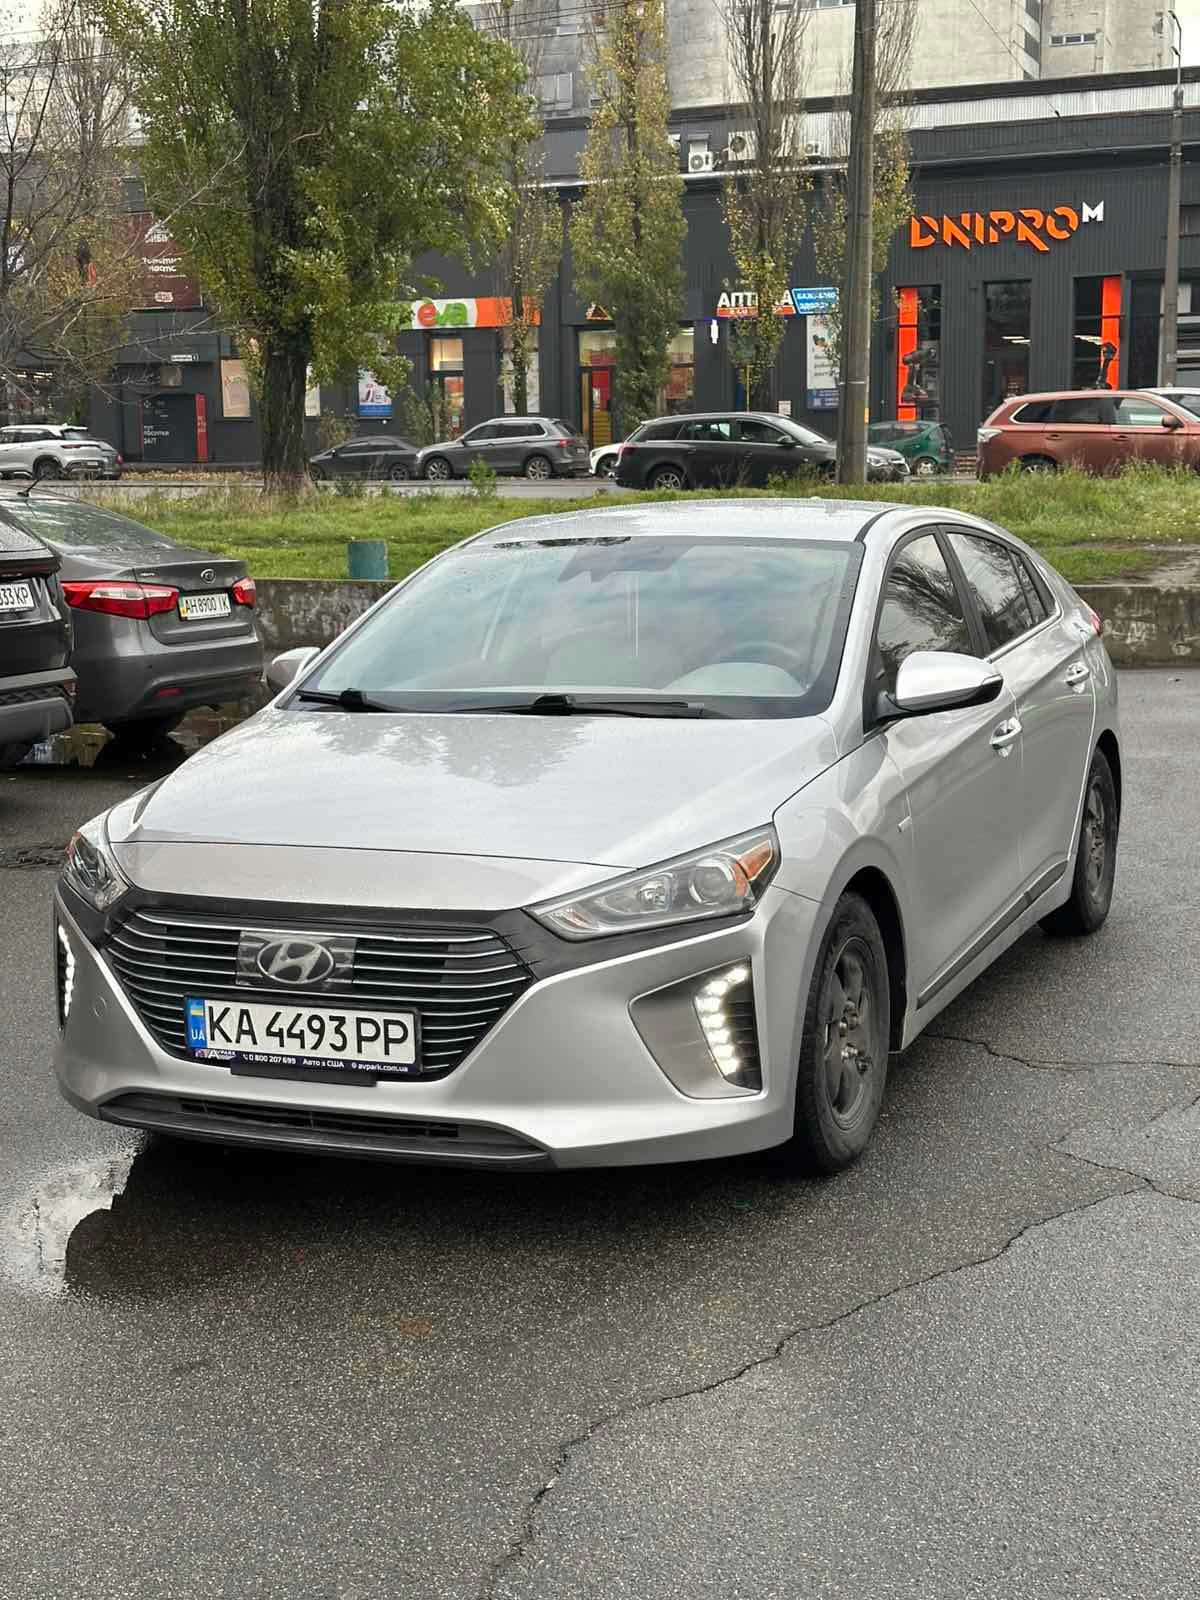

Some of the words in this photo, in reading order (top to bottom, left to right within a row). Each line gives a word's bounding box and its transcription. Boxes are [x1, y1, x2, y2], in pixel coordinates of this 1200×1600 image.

[910, 206, 1080, 251] DNIPRO
[717, 290, 794, 308] АПТА
[14, 586, 28, 604] KP
[191, 1029, 204, 1040] UA
[208, 1006, 257, 1045] KA
[265, 1011, 347, 1051] 4493
[356, 1016, 408, 1056] PP
